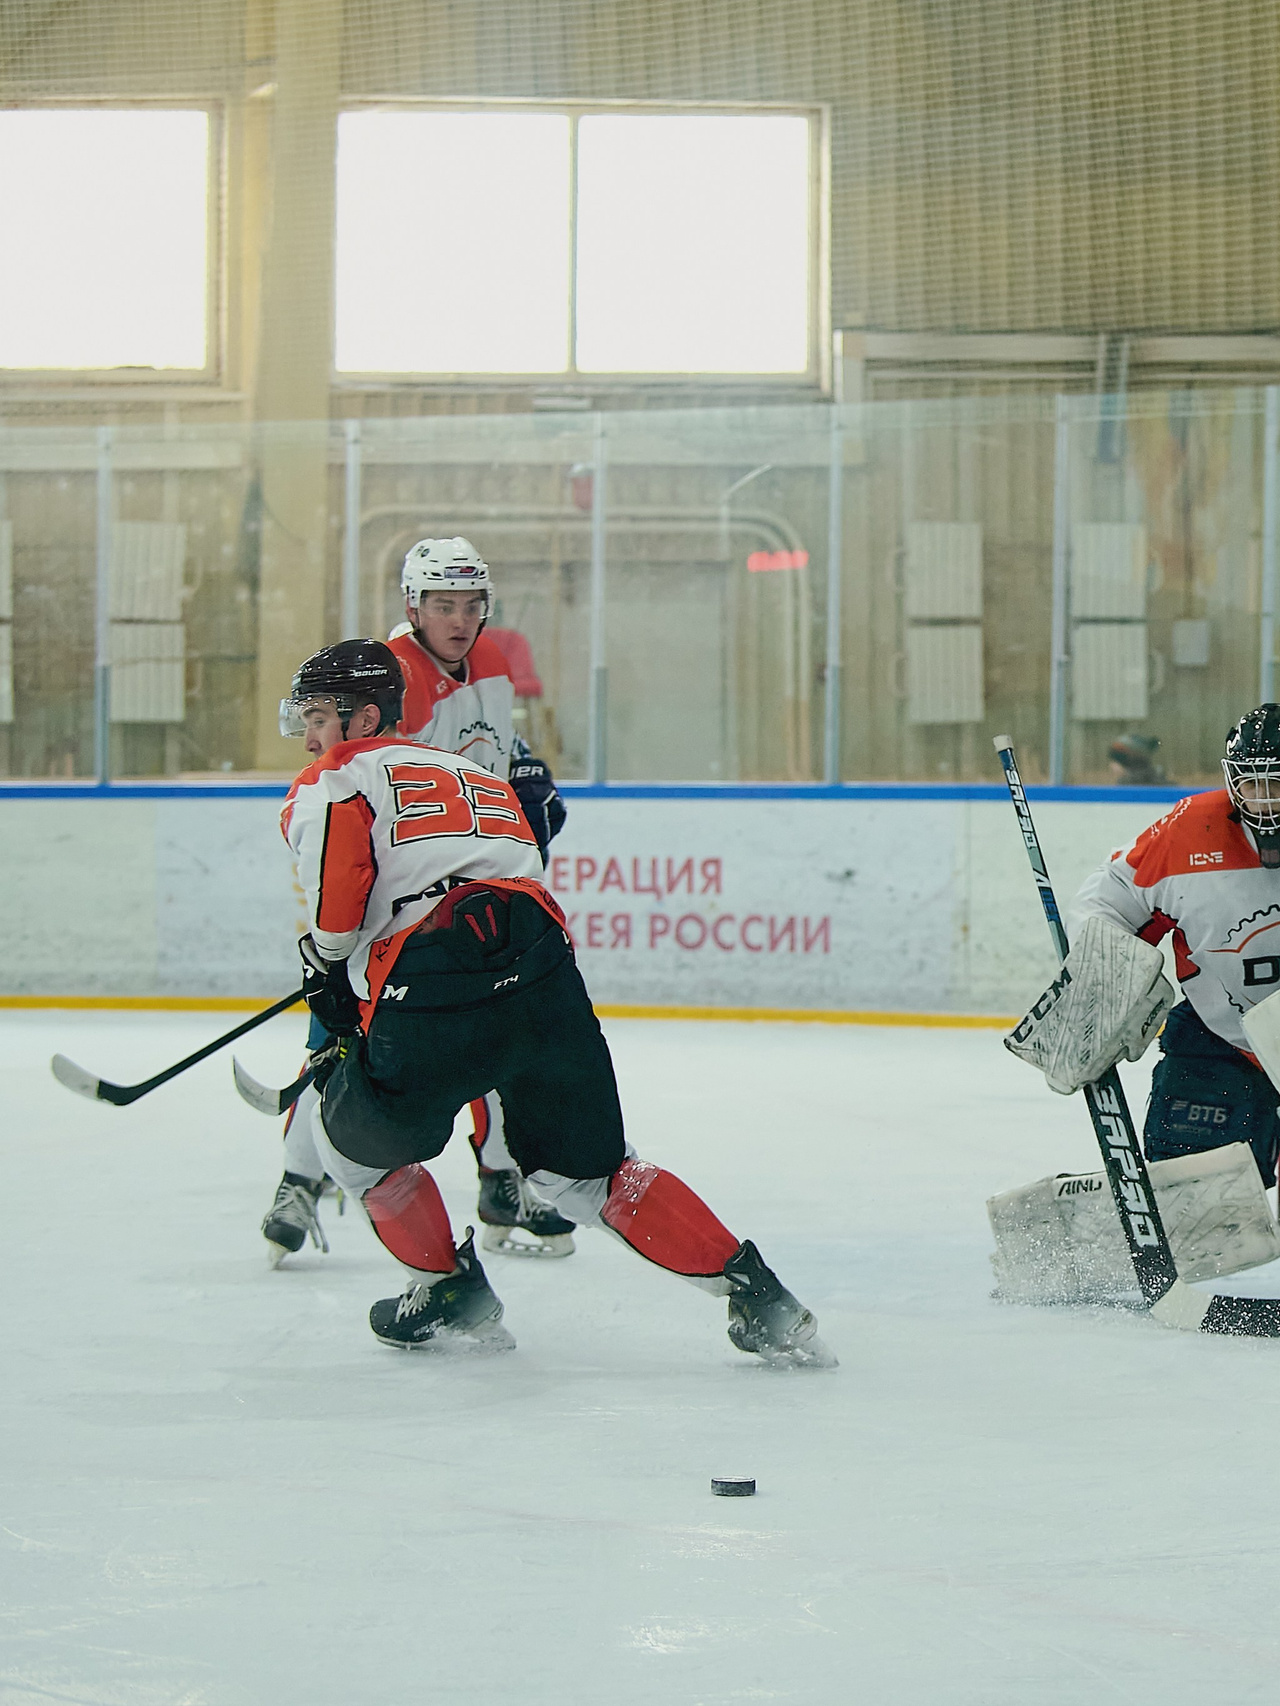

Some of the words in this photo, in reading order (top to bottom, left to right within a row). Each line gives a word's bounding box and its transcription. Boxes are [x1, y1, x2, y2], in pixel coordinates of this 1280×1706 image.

[384, 762, 540, 848] 33
[551, 856, 722, 900] ЕРАЦИЯ
[649, 911, 832, 954] РОССИИ
[1011, 966, 1073, 1044] CCM
[1187, 1104, 1228, 1124] ВТБ
